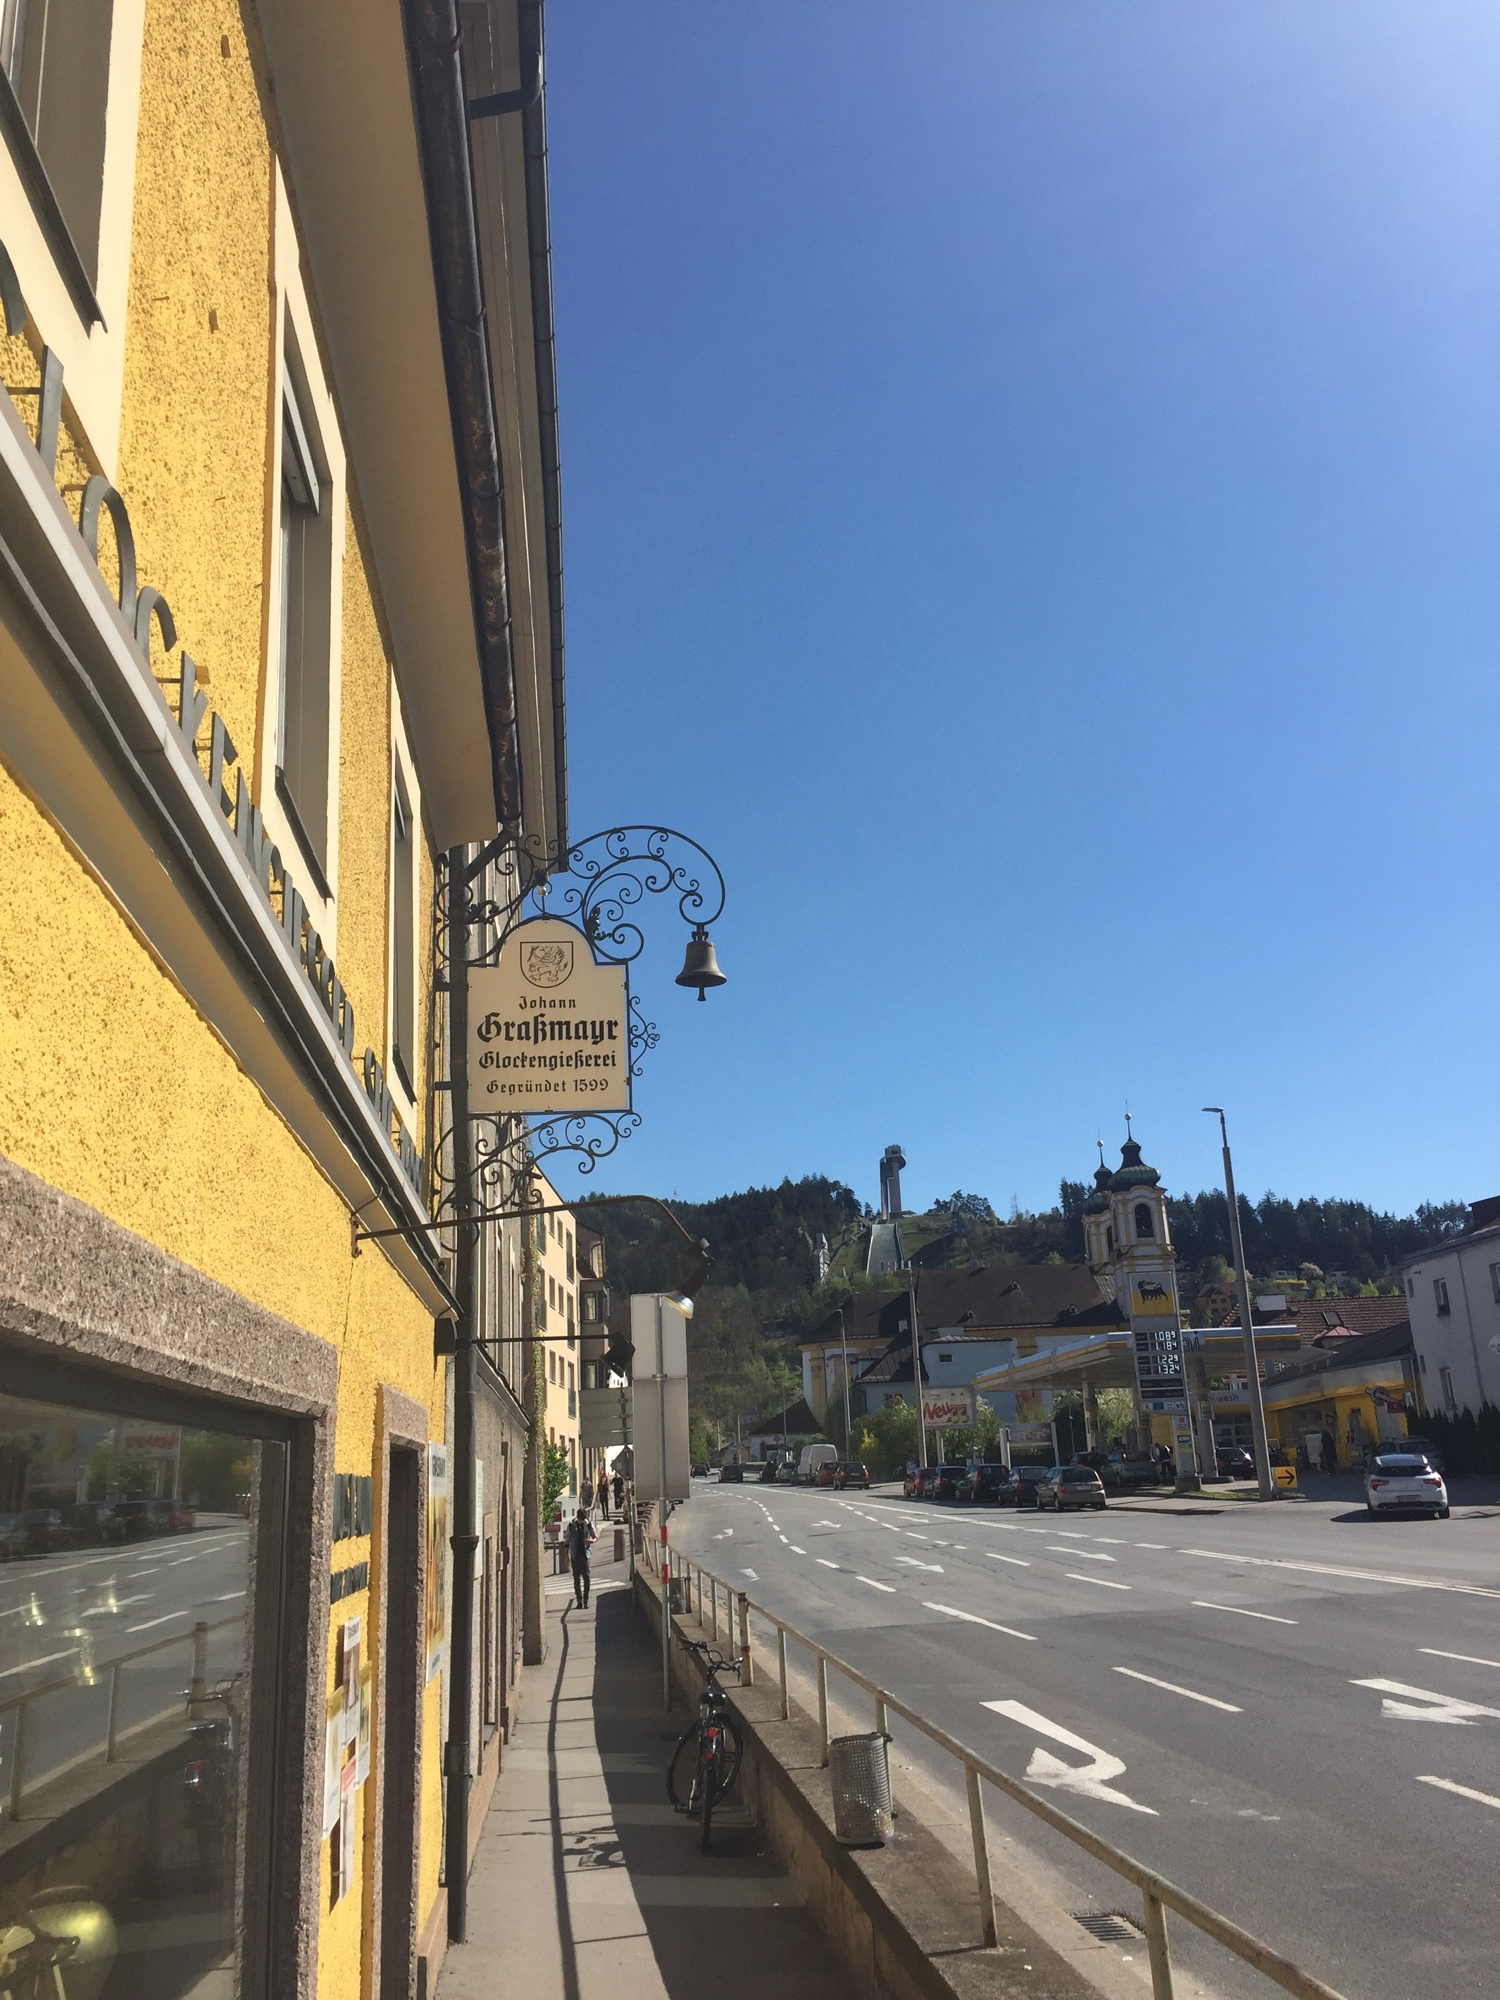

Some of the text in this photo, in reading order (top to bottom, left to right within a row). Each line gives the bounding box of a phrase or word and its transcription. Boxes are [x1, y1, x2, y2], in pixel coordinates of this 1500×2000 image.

[519, 996, 577, 1010] Johann
[477, 1012, 619, 1045] Graßmayr
[479, 1050, 617, 1071] Glockengießerei
[486, 1078, 609, 1097] Gegründet 1599
